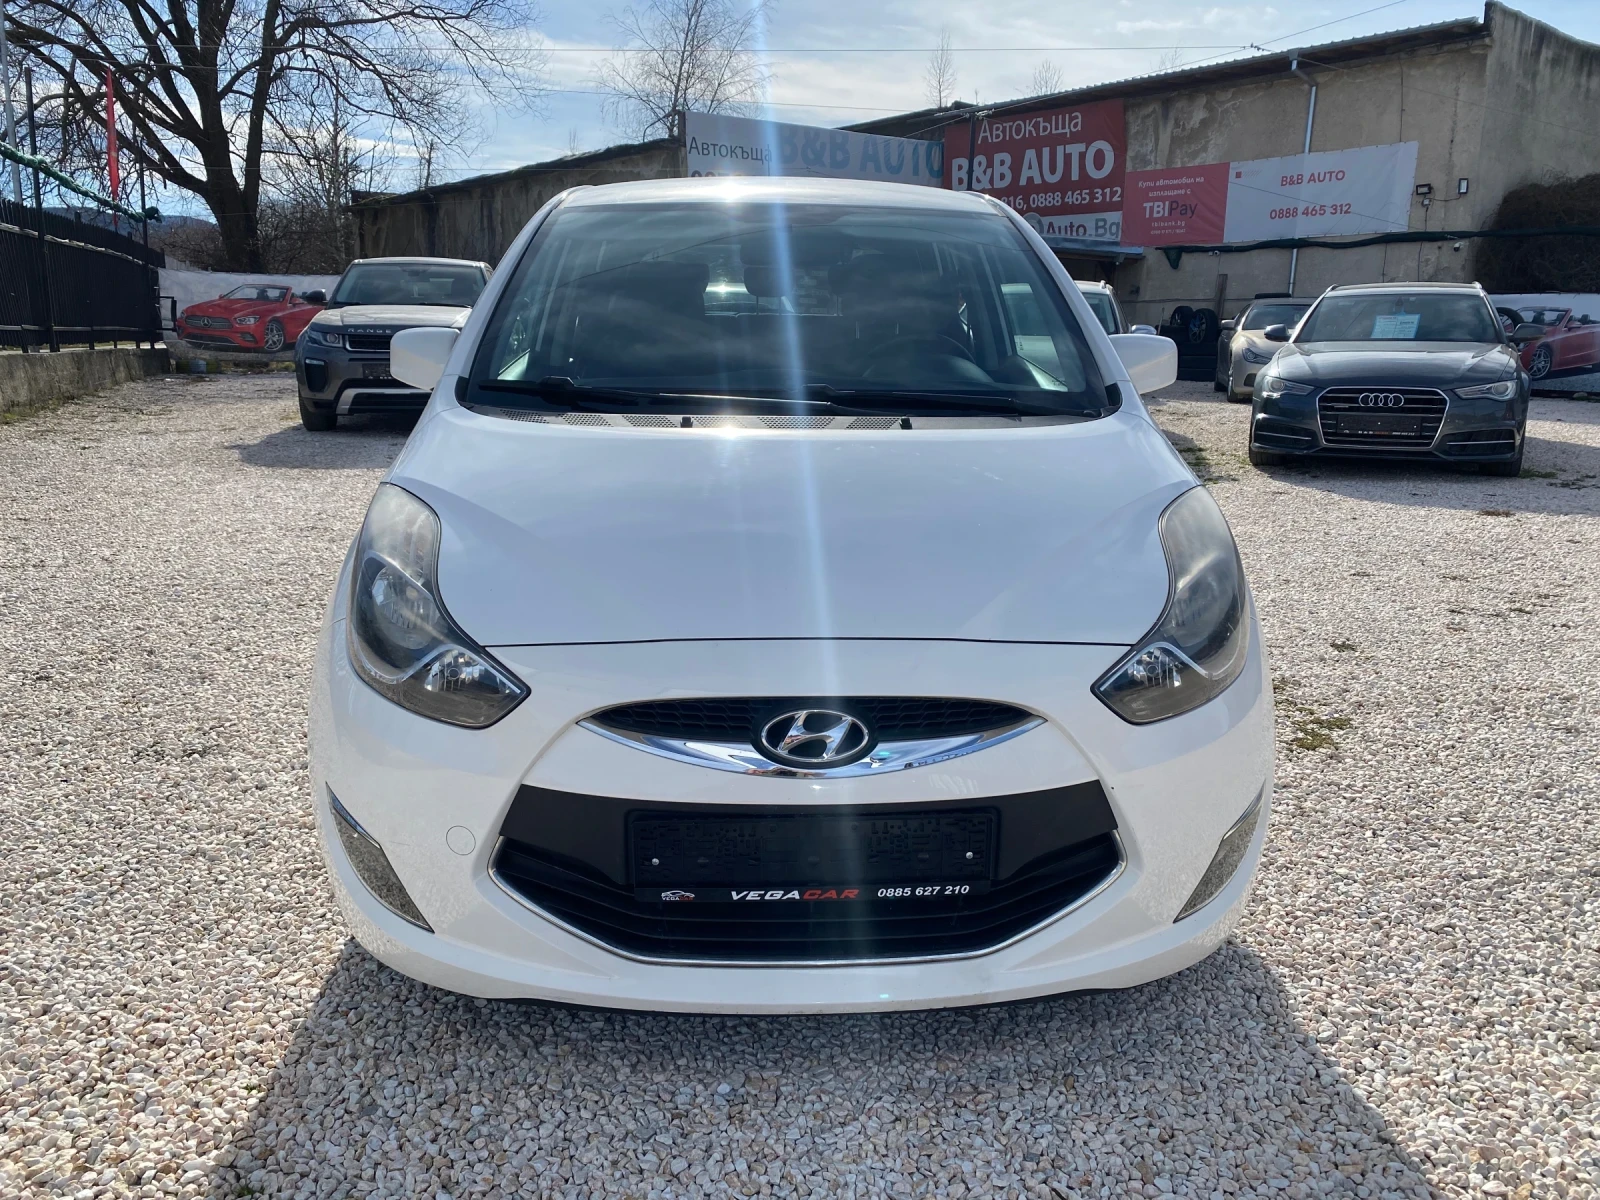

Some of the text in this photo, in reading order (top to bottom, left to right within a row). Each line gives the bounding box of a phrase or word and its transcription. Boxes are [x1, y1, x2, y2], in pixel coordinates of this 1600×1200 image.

[978, 111, 1082, 144] Автокъща
[688, 136, 773, 164] Автокъща
[780, 128, 944, 179] B&B AUTO
[951, 139, 1115, 191] B&B AUTO
[1280, 169, 1346, 187] B&B AUTO
[1029, 191, 1062, 208] 0888
[1064, 189, 1090, 205] 465
[1093, 186, 1122, 203] 312
[1143, 200, 1198, 219] TBIPay
[1269, 202, 1352, 220] 0888 465 312
[877, 888, 911, 898] 0885
[915, 886, 941, 896] 627
[944, 885, 970, 895] 210
